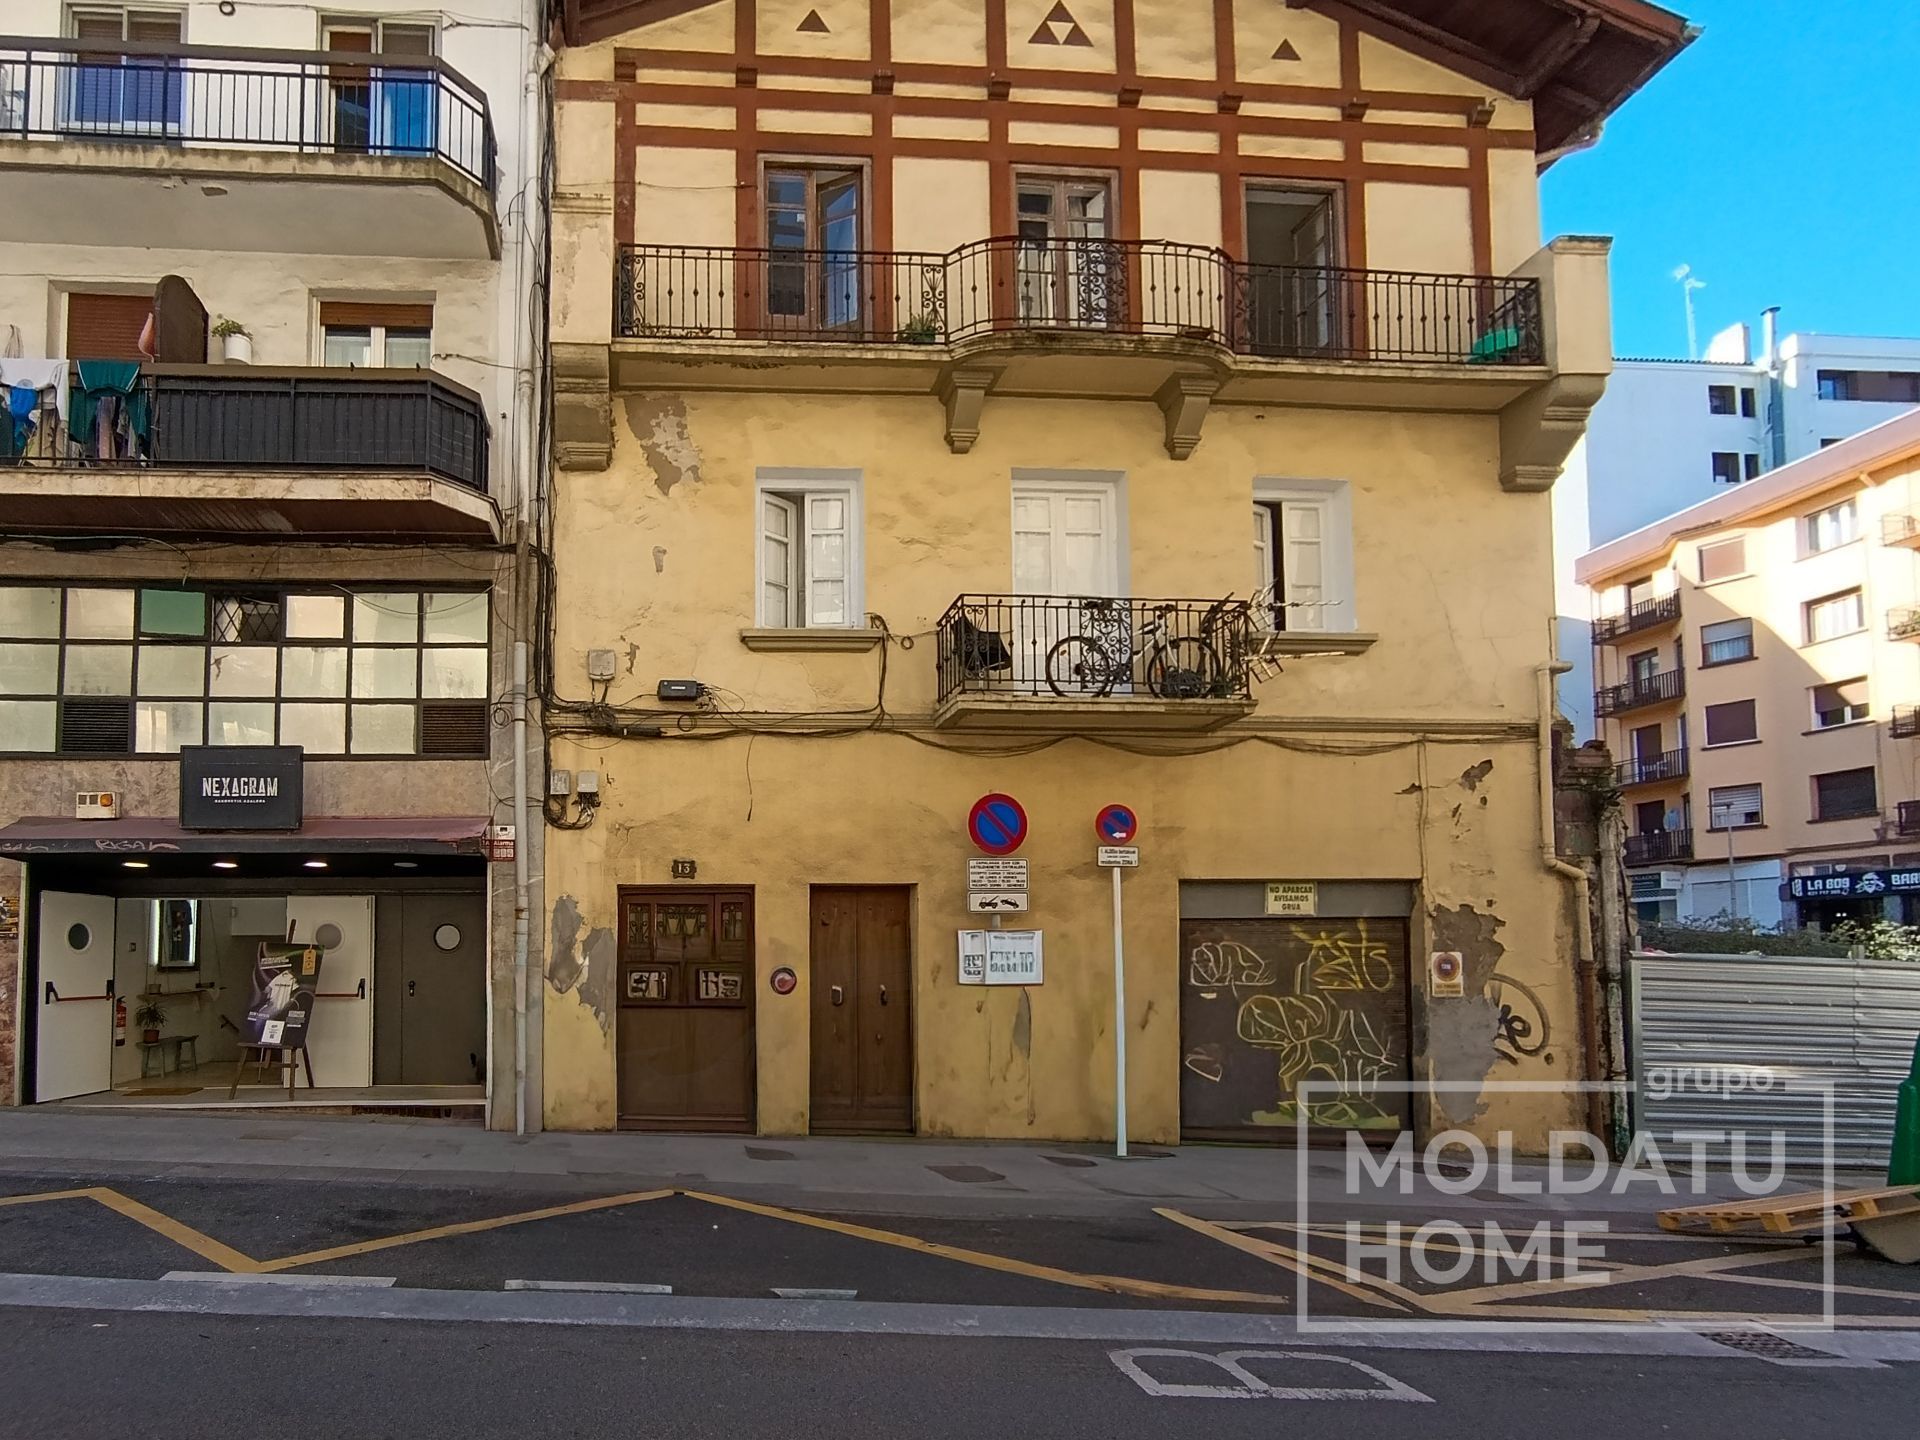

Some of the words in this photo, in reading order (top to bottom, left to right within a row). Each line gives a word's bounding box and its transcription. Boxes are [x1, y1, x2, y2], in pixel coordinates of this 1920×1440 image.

[202, 777, 278, 797] NEXAGRAM
[677, 863, 691, 874] 13
[1807, 879, 1823, 890] LA
[1826, 878, 1850, 889] 809
[1891, 872, 1920, 885] BAR
